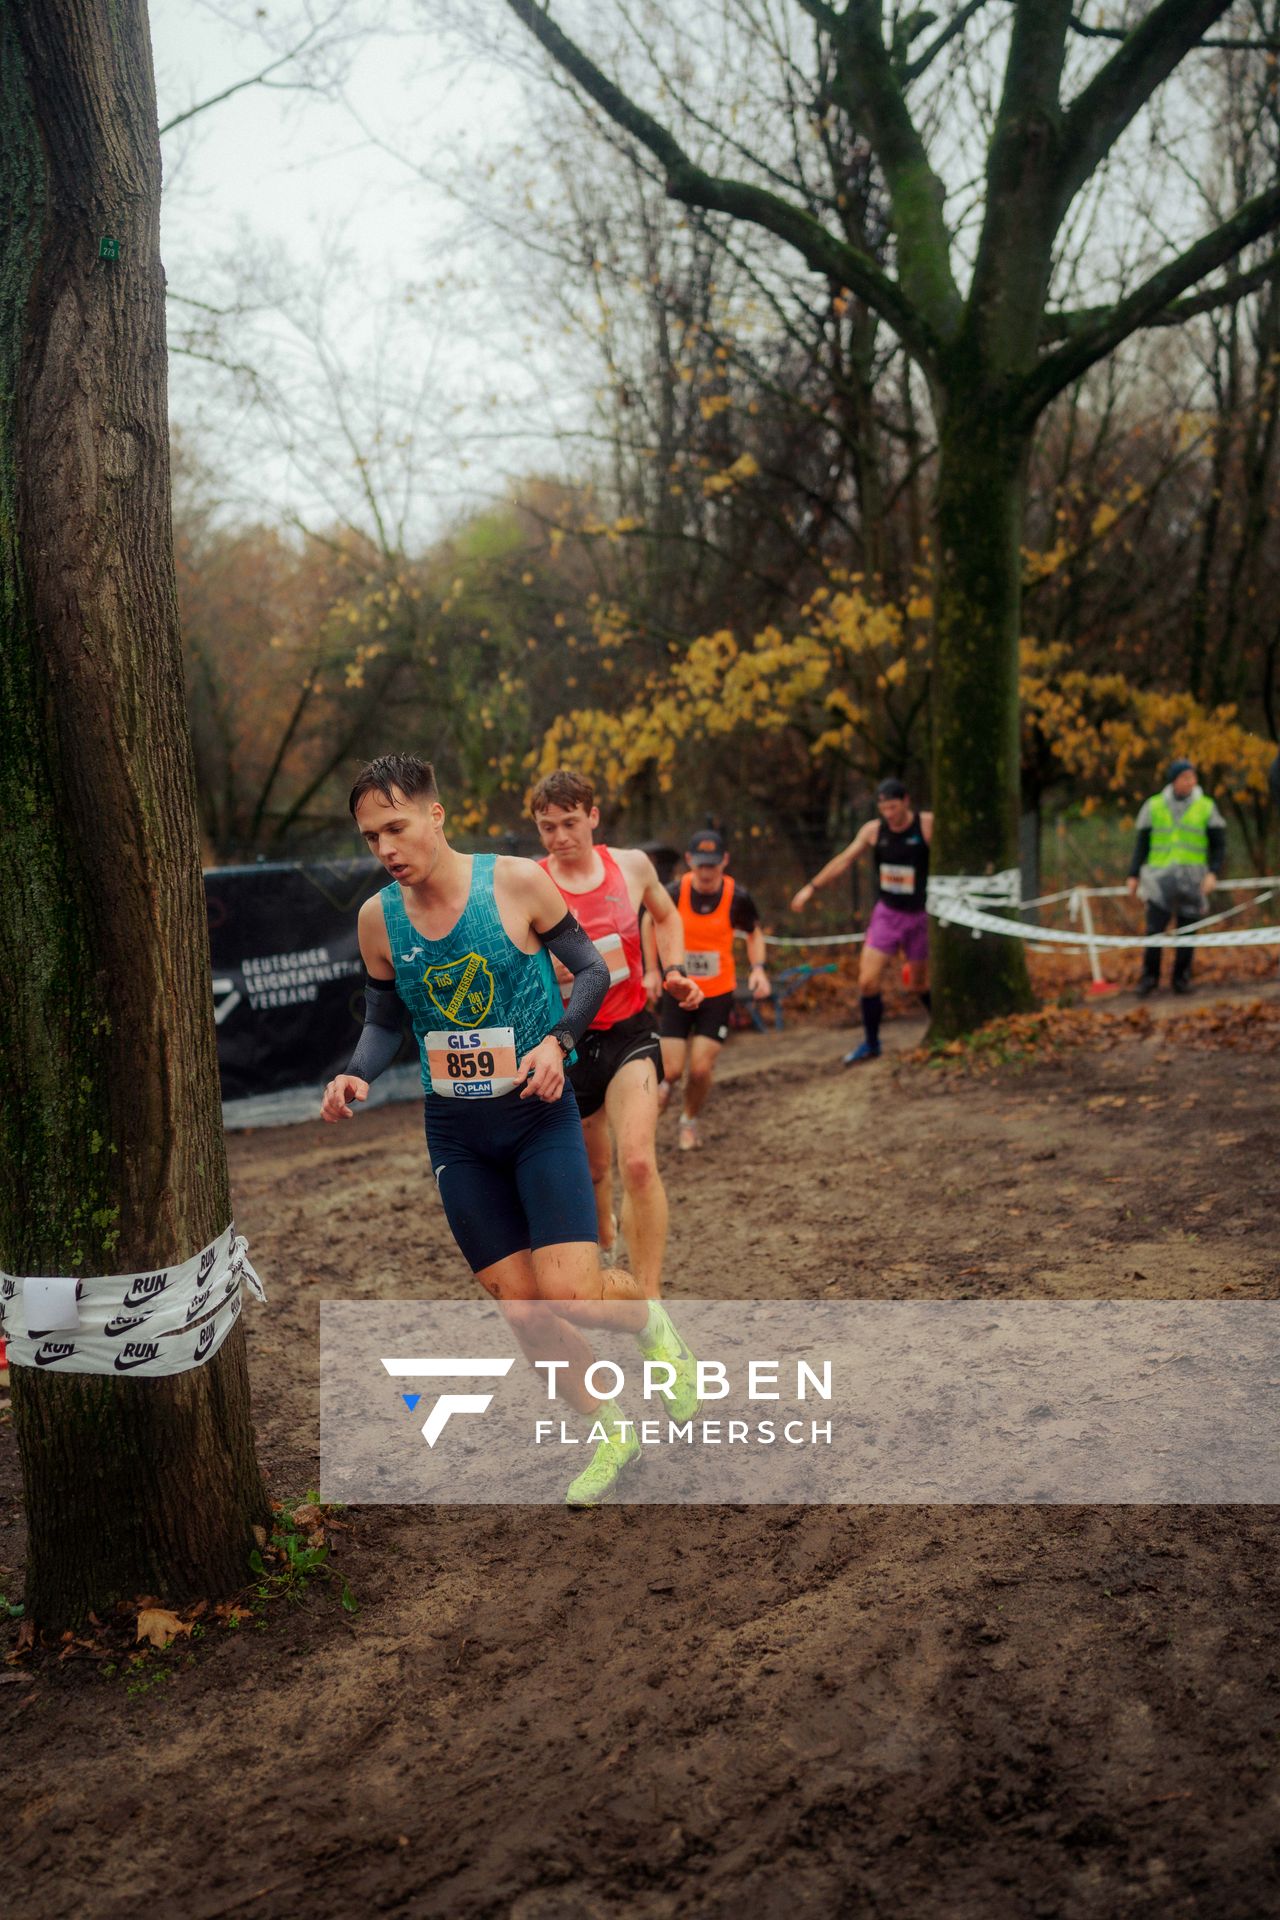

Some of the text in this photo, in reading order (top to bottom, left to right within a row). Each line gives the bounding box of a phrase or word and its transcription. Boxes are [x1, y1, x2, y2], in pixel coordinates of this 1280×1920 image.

[242, 948, 329, 976] DEUTSCHER
[433, 973, 453, 988] TuS
[448, 957, 480, 1015] FRAMERSHEIM
[249, 985, 318, 1010] VERBAND
[446, 1051, 495, 1079] 859
[467, 1083, 491, 1092] PLAN
[200, 1246, 216, 1272] RUN
[131, 1273, 168, 1294] RUN
[200, 1320, 216, 1346] RUN
[42, 1341, 75, 1354] RUN
[123, 1342, 159, 1358] RUN
